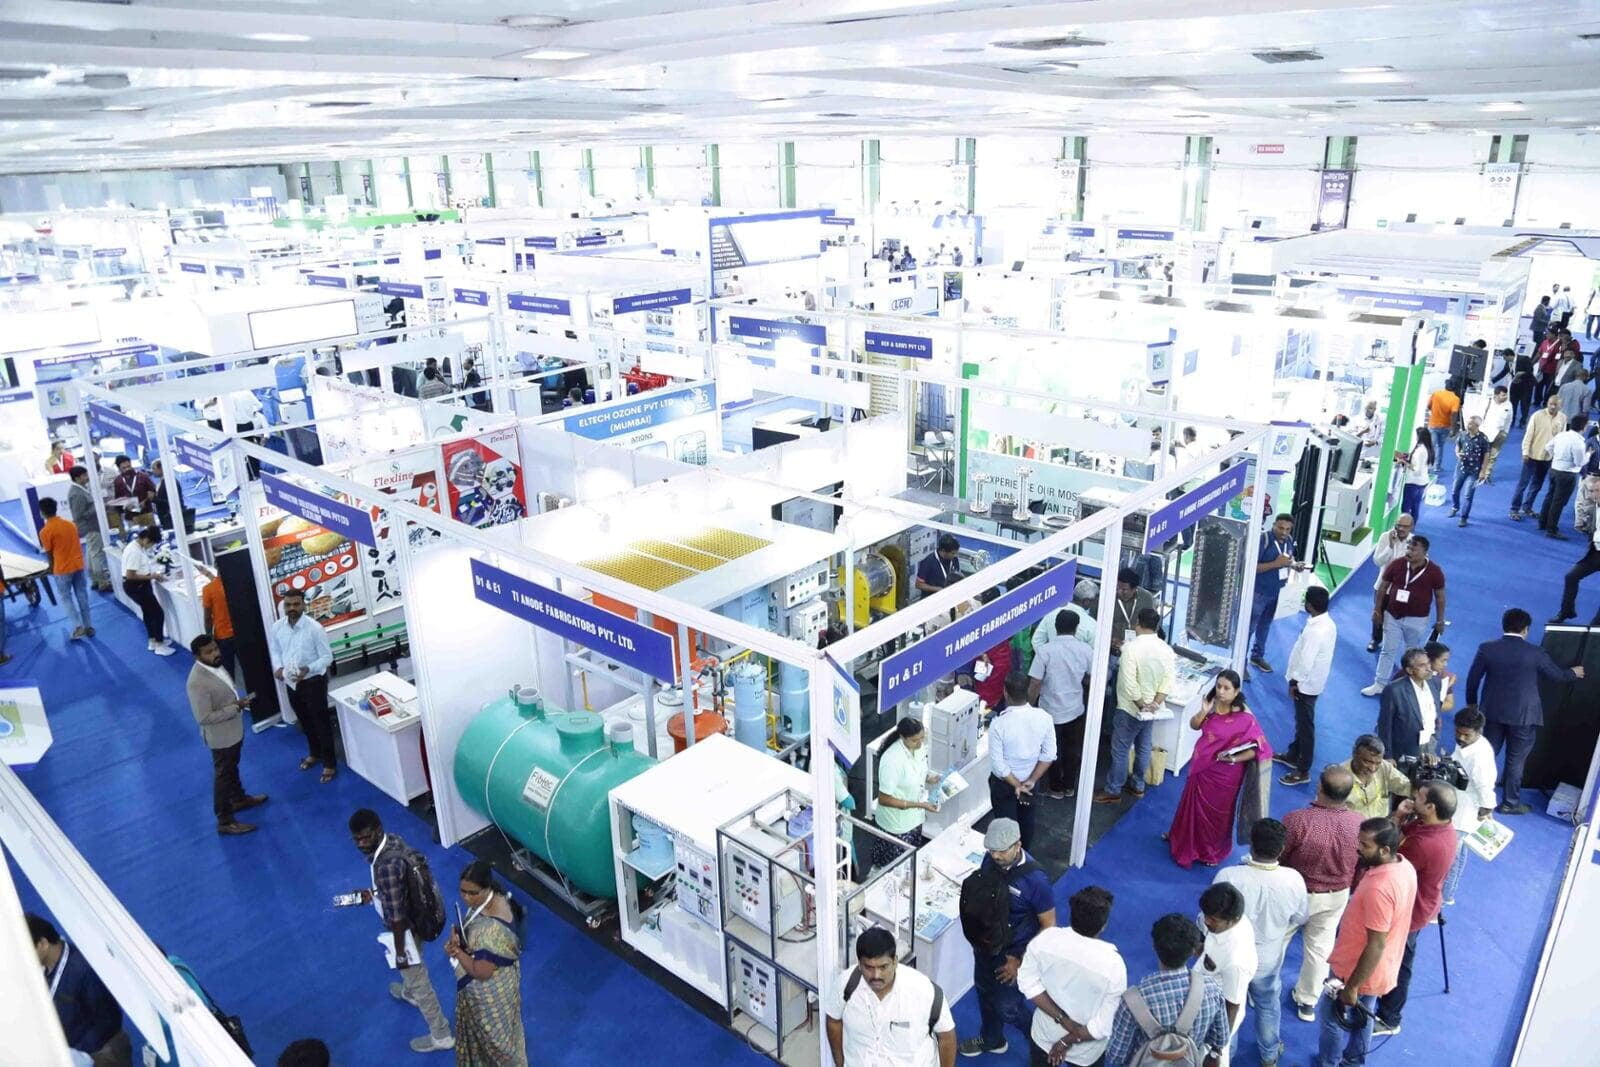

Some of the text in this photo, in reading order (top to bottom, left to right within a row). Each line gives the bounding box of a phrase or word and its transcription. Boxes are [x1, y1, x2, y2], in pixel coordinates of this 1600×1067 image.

[578, 414, 610, 428] ELTECH
[612, 404, 642, 418] OZONE
[609, 415, 652, 434] (MUMBAI)
[374, 472, 414, 487] Flexline
[1058, 488, 1080, 502] MOS
[475, 574, 636, 652] D1 & E1 TI ANODE FABRICATORS PVT. LTD.
[888, 584, 1057, 690] D1 & E1 TI ANODE FABRICATORS PVT. LTD.
